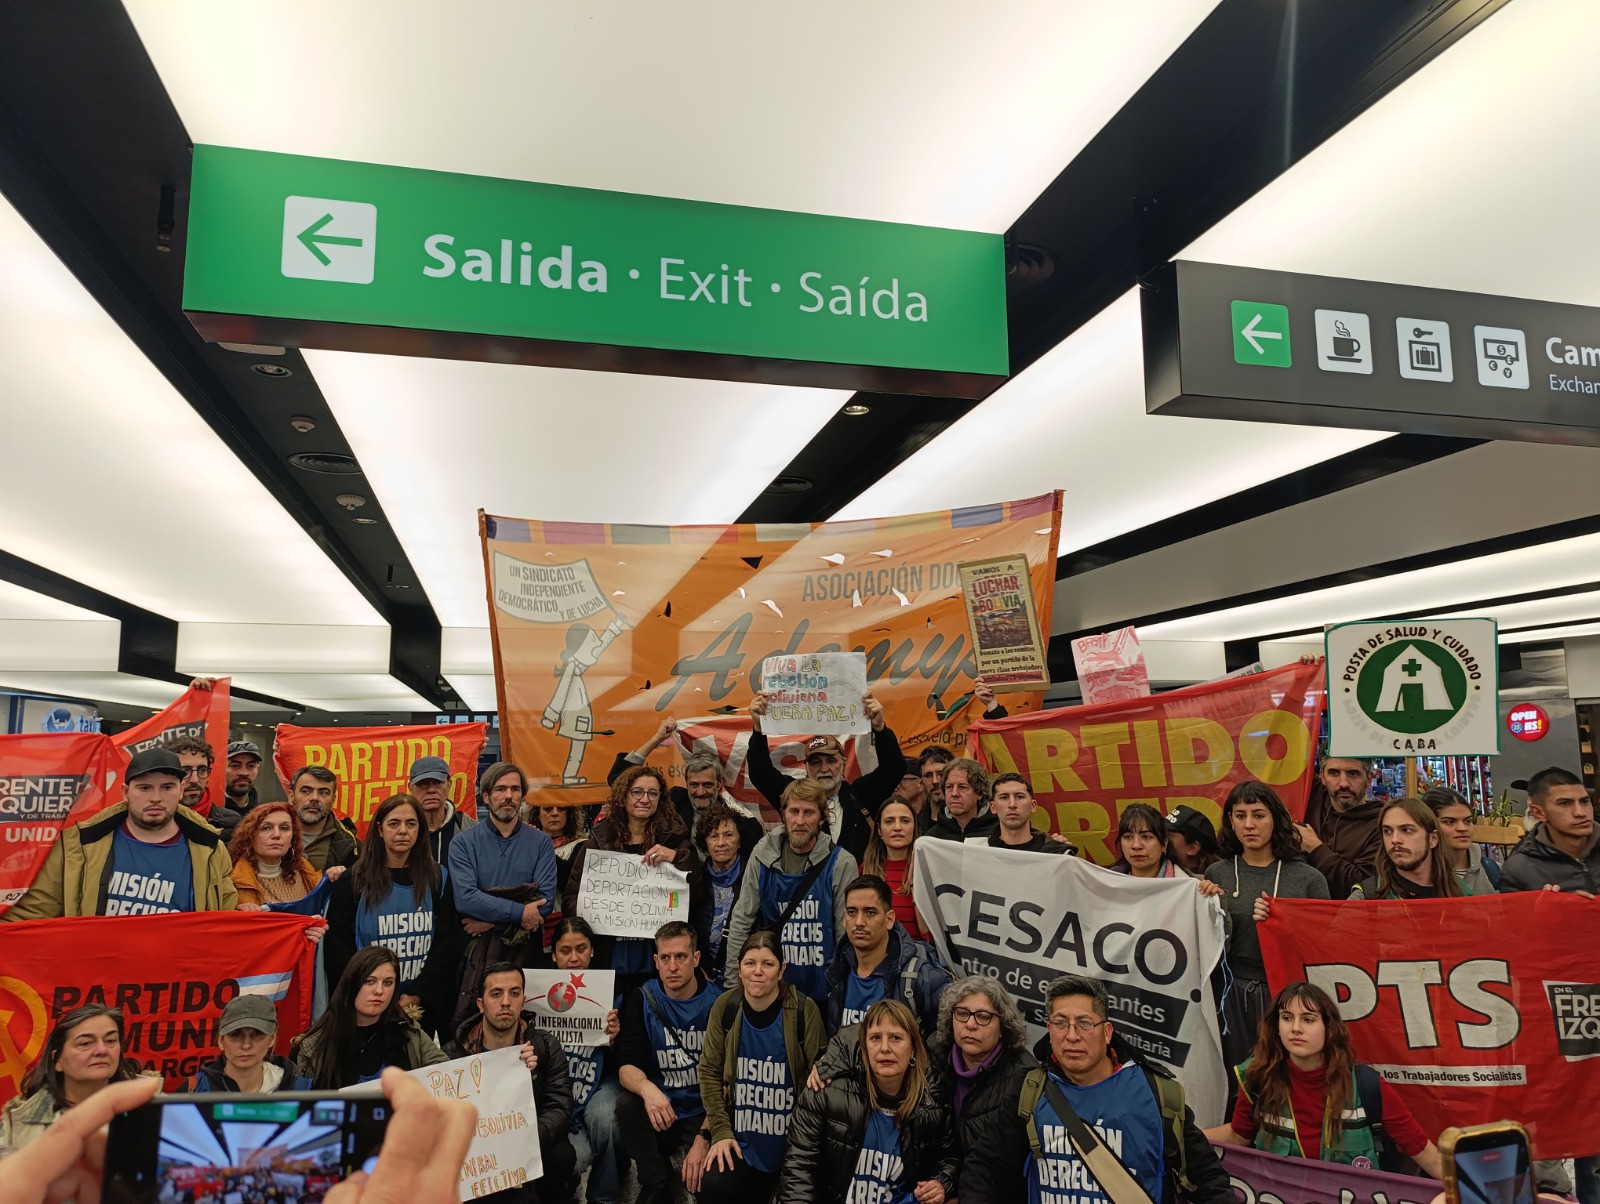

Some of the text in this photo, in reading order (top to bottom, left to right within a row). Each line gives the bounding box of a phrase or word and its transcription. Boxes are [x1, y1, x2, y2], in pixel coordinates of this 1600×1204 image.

[422, 233, 929, 323] Salida Exit Saída
[509, 564, 576, 583] UN SINDICATO
[802, 563, 923, 602] ASOCIACIÓN
[971, 566, 1001, 576] VAMOS
[520, 580, 587, 598] INDEPENDIENTE
[971, 575, 1020, 598] LUCHAR
[498, 588, 559, 613] DEMOCRÁTICO
[559, 595, 604, 621] Y DE LUCHA
[978, 593, 1021, 613] BOLIVIA
[1343, 626, 1482, 681] POSTA DE SALUD Y CUIDADO
[816, 703, 857, 727] PAZ!
[1511, 710, 1537, 722] OPEN
[1393, 738, 1436, 750] CABA
[0, 796, 76, 815] QUIER
[586, 852, 649, 879] REPUDIO
[583, 896, 625, 912] DESDE
[378, 906, 433, 936] MISIÓN
[1005, 967, 1033, 990] de
[51, 978, 241, 1020] PARTIDO
[1304, 957, 1522, 1051] PTS
[538, 1015, 603, 1030] INTERNACIONAL
[427, 1058, 482, 1099] PAZ!
[1383, 1070, 1523, 1083] los Trabajadores Socialistas
[477, 1110, 529, 1138] BOLIVIA
